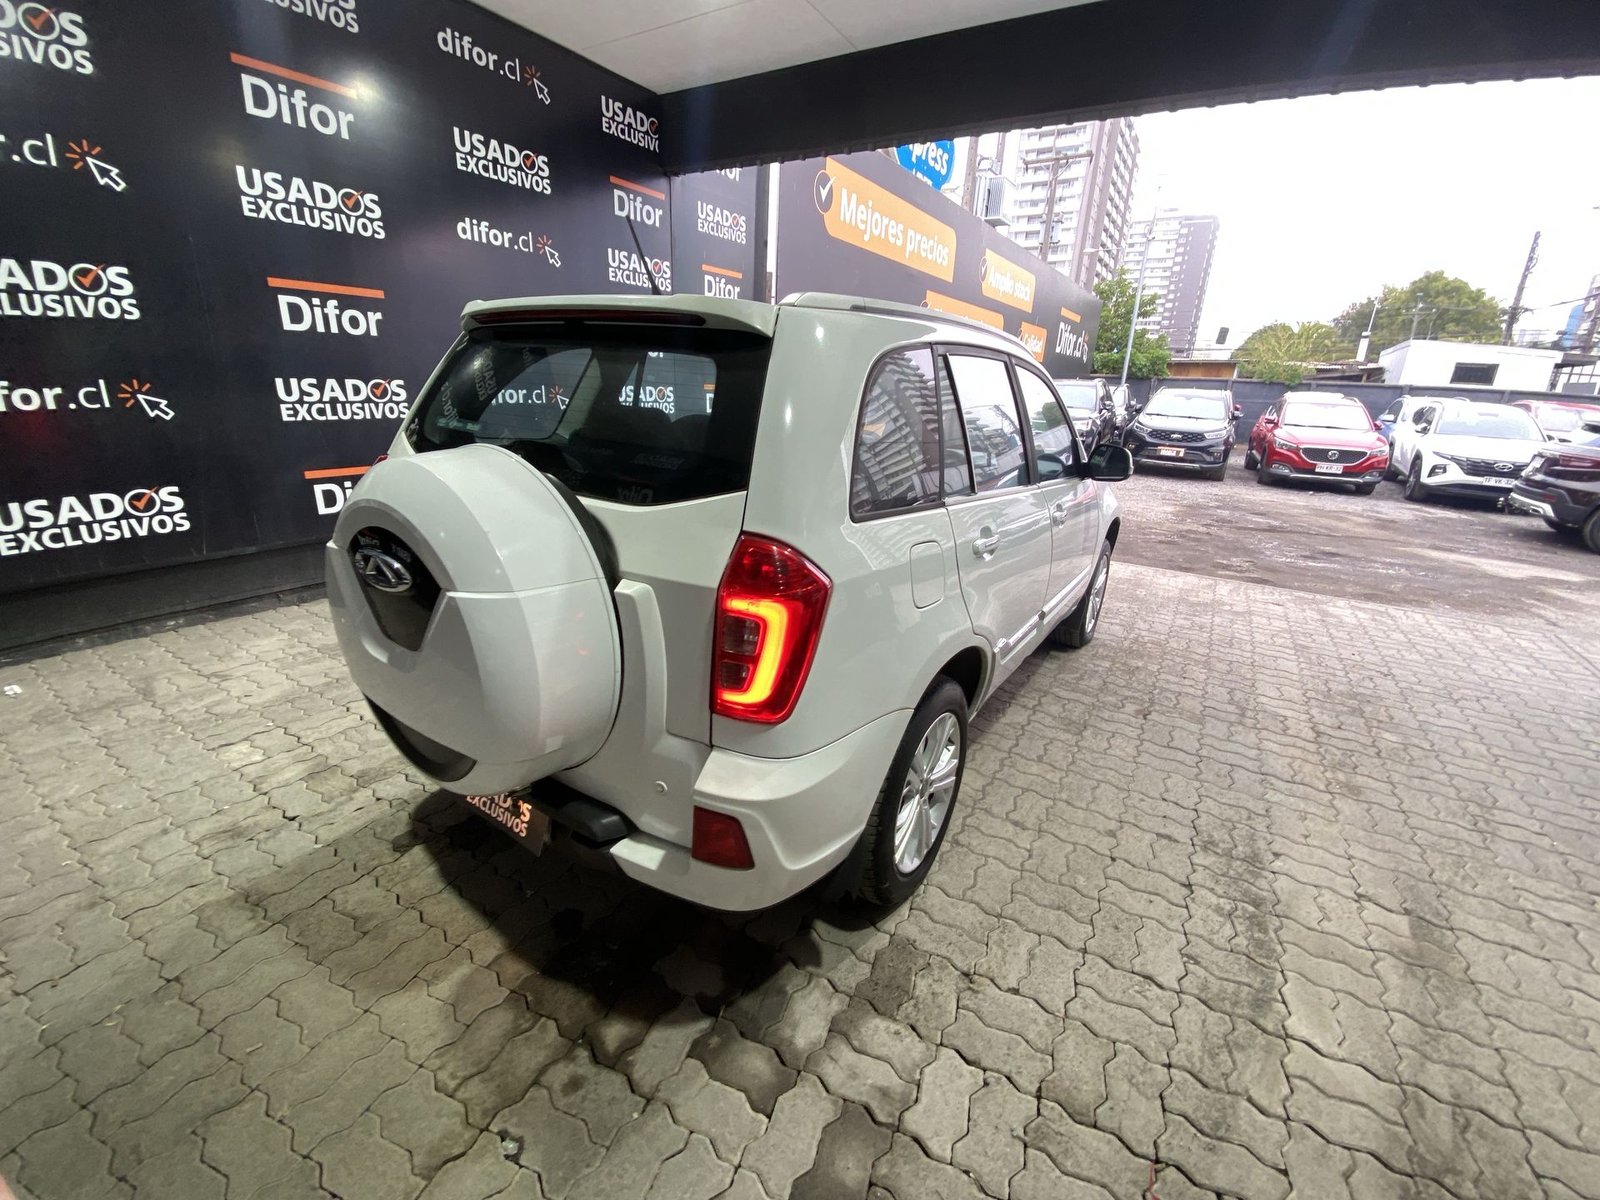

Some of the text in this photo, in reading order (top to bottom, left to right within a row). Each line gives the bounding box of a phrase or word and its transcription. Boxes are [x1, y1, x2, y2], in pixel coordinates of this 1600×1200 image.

[437, 27, 520, 82] difor.cl
[241, 73, 355, 140] Difor
[453, 126, 550, 178] USADOS
[909, 142, 949, 176] press
[235, 165, 382, 219] USADOS
[455, 151, 552, 195] EXCLUSIVOS
[241, 195, 386, 240] EXCLUSIVOS
[613, 188, 663, 228] Difor
[697, 201, 746, 232] USADOS
[840, 187, 950, 267] Mejores precios
[457, 217, 533, 252] difor.cl
[697, 219, 747, 245] EXCLUSIVOS
[0, 292, 141, 320] LUSIVOS
[704, 274, 741, 300] Difor
[277, 294, 384, 337] Difor
[274, 377, 408, 403] USADOS
[279, 402, 410, 422] EXCLUSIVOS
[0, 512, 191, 556] EXCLUSIVOS
